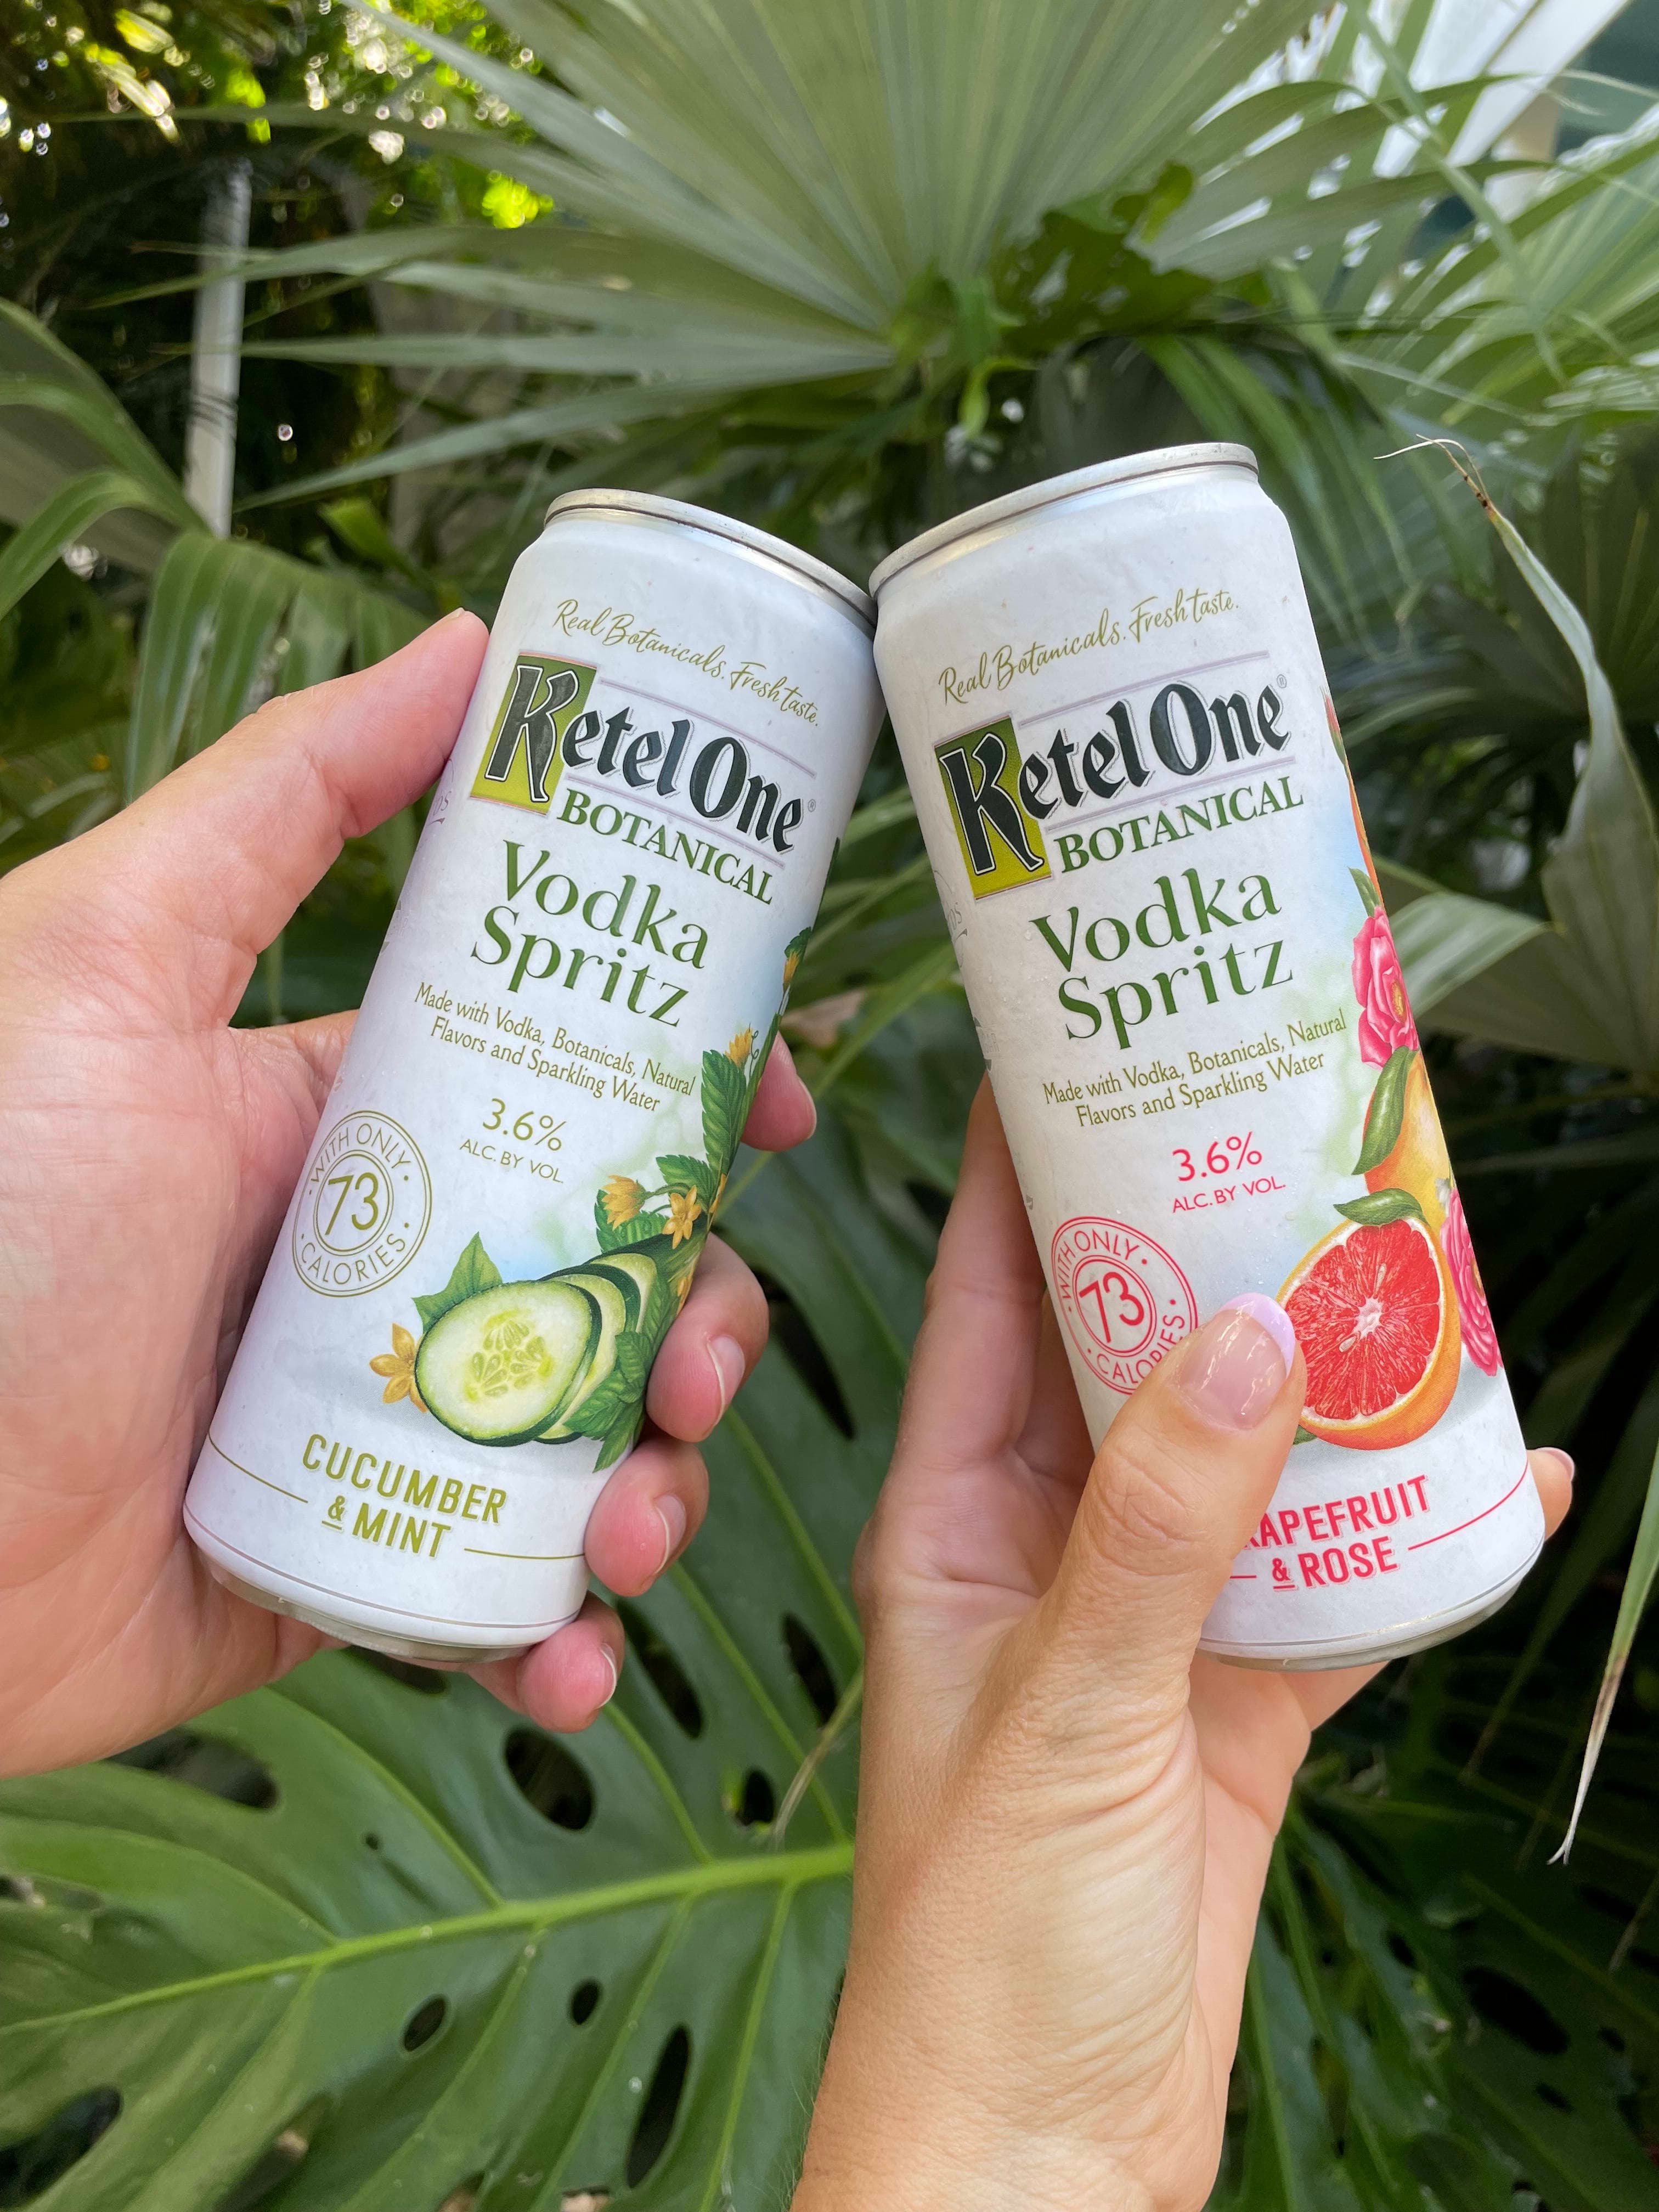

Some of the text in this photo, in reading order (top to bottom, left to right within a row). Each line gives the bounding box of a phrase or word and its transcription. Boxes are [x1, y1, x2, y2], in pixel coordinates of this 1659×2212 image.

[552, 600, 612, 636] Real
[602, 614, 725, 680] Botanicals.
[731, 662, 787, 702] Fresh
[938, 652, 991, 704] Real
[992, 608, 1126, 690] Botanicals.
[1128, 588, 1188, 642] Fresh
[484, 664, 694, 803] Ketel
[939, 699, 1154, 876] Ketel
[1054, 775, 1304, 873] BOTANICAL
[557, 788, 773, 905] BOTANICAL
[503, 839, 710, 969] Vodka
[1031, 868, 1282, 972] Vodka
[471, 906, 689, 1027] Spritz
[1058, 939, 1293, 1049] Spritz
[414, 982, 696, 1096] Made with Vodka, Botanicals, Natural
[431, 1015, 660, 1111] Flavors and Sparkling Water
[1043, 1008, 1346, 1104] Made with Vodka, Botanicals, Natural
[483, 1098, 567, 1151] 3.6%
[1076, 1052, 1325, 1126] Flavors and Sparkling Water
[311, 1124, 411, 1183] WITH ONLY
[459, 1138, 496, 1161] ALC.
[500, 1151, 524, 1168] BY
[1172, 1131, 1262, 1182] 3.6%
[1172, 1176, 1286, 1213] ALC. BY VOL.
[325, 1172, 378, 1235] 73
[302, 1233, 405, 1284] CALORIES
[1058, 1229, 1139, 1299] WITH ONLY
[1079, 1272, 1144, 1343] 73
[302, 1434, 507, 1525] CUCUMBER
[1242, 1475, 1427, 1548] APEFRUIT
[328, 1495, 452, 1558] & MINT
[1272, 1536, 1398, 1587] & ROSE
